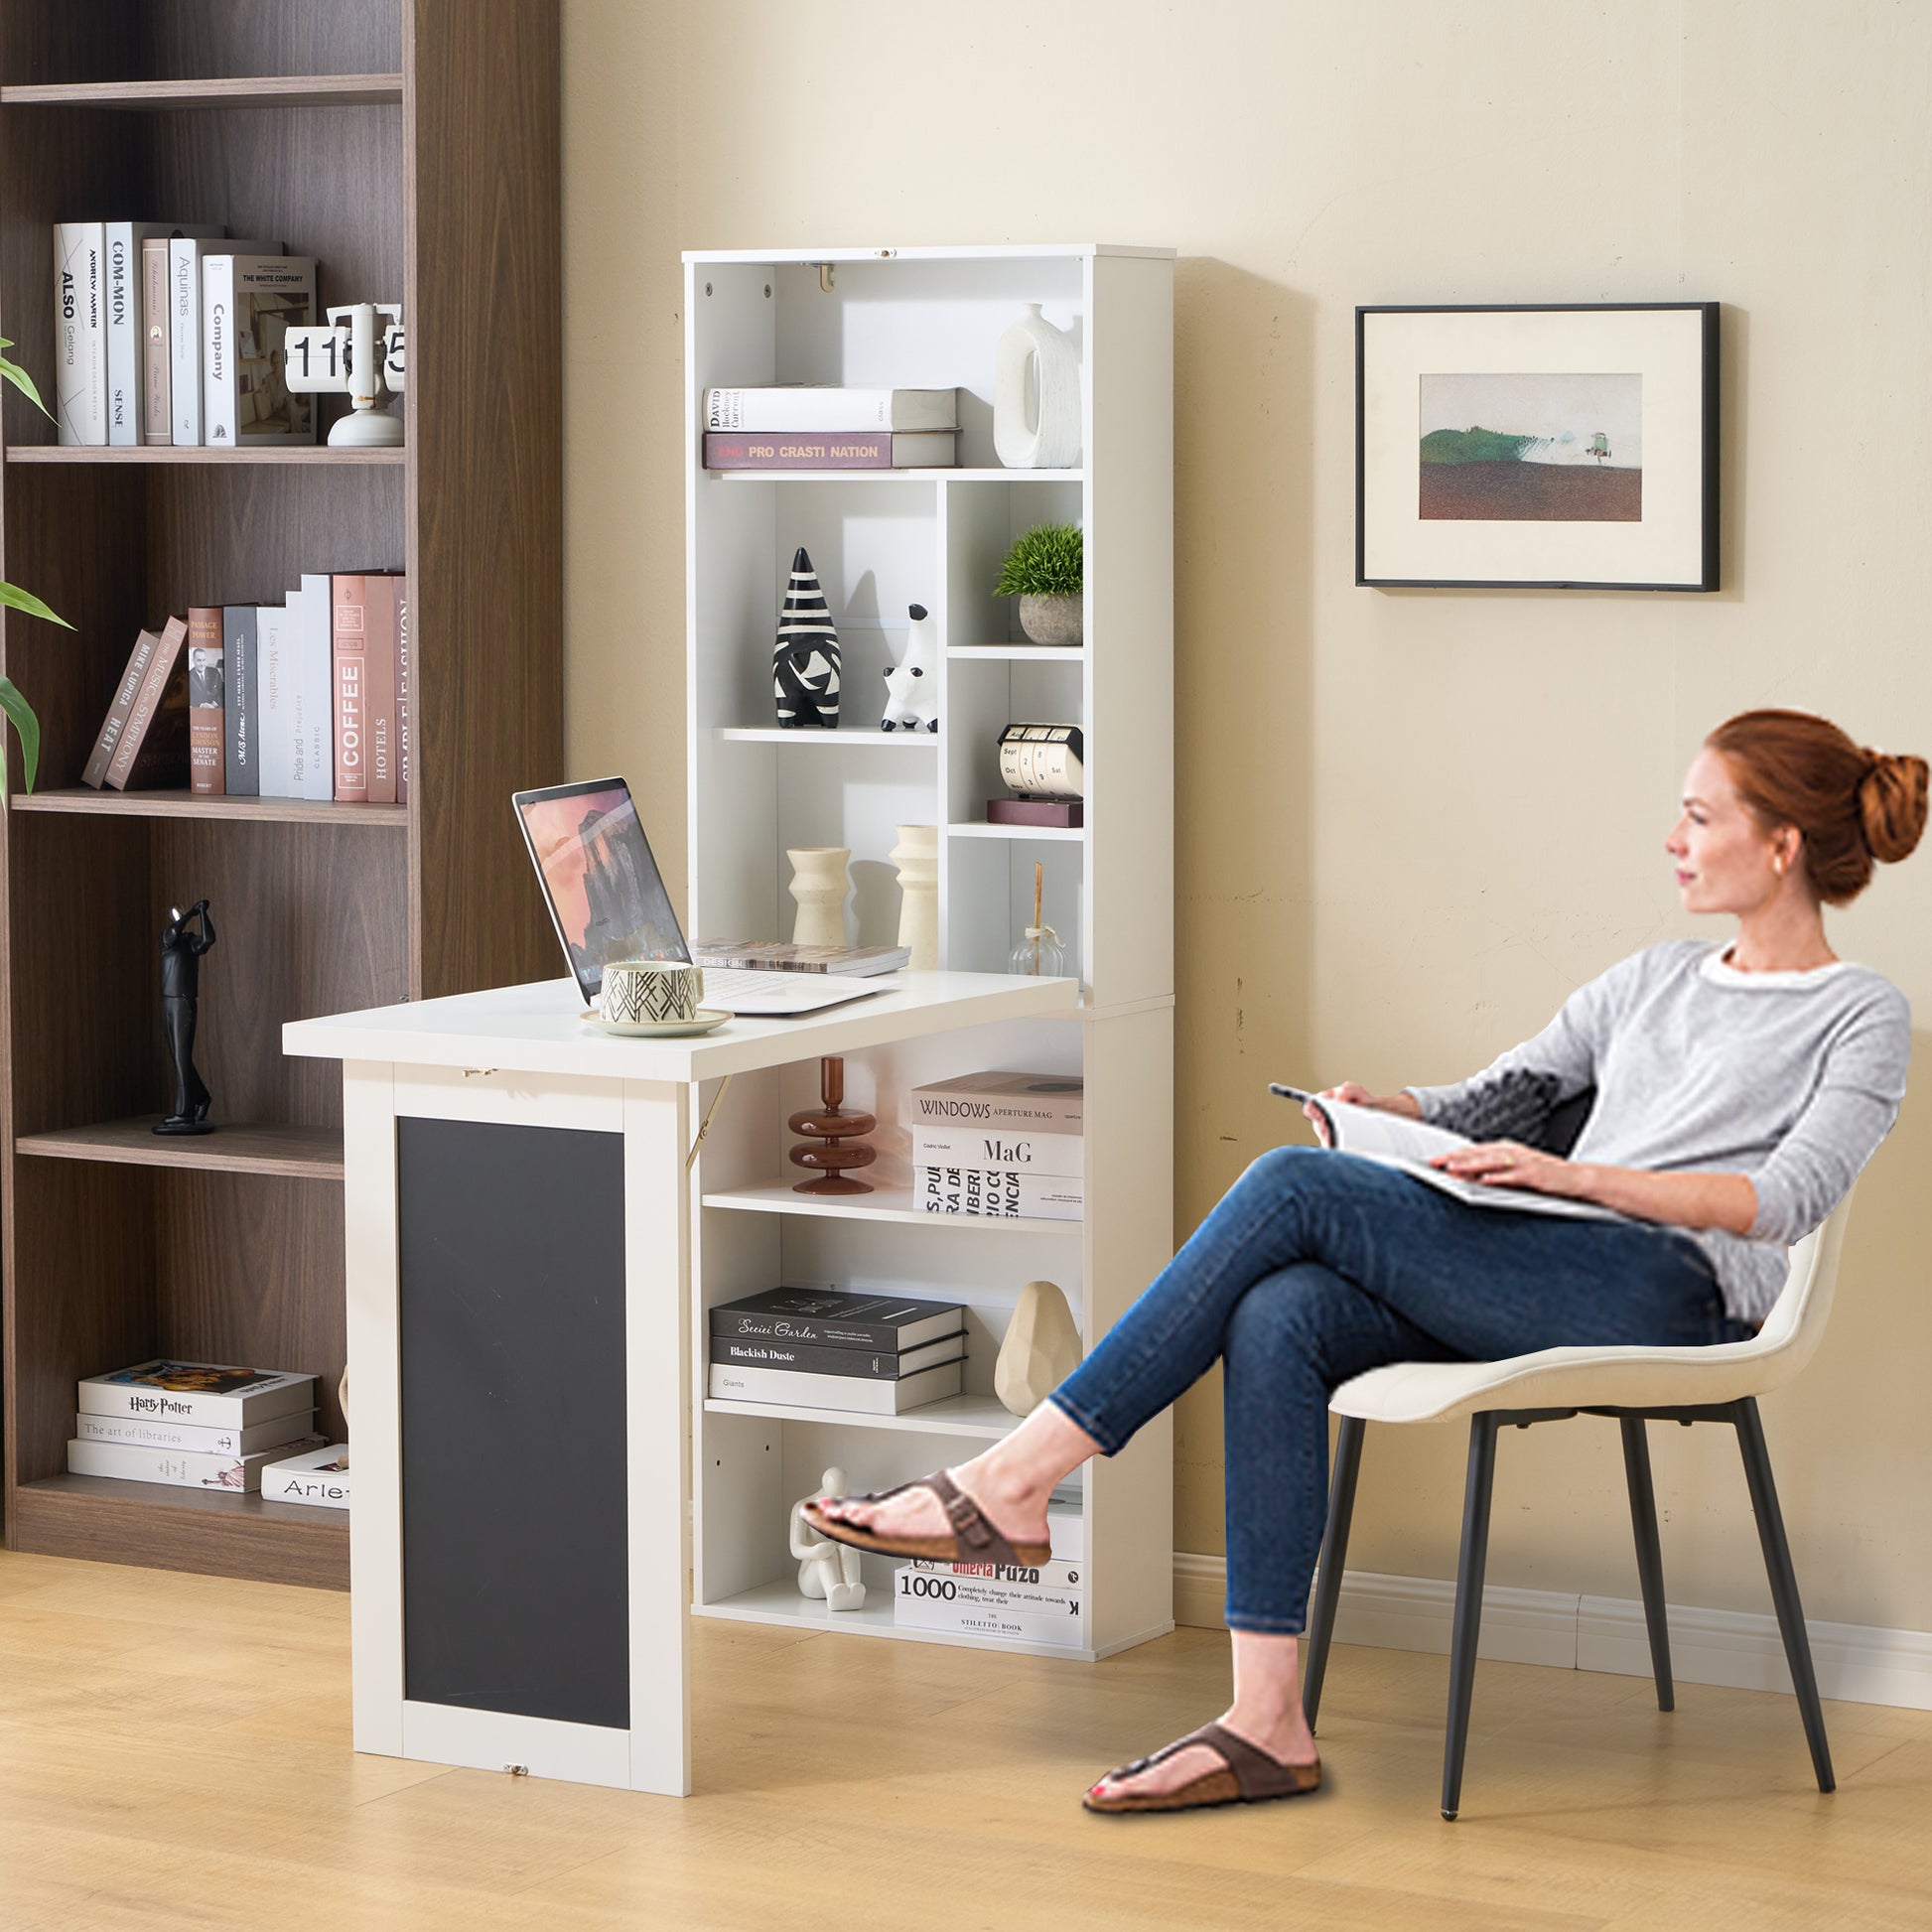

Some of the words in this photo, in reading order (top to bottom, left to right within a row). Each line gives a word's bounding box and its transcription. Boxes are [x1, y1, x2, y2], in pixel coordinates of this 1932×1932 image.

[62, 271, 74, 319] ALSO
[112, 240, 124, 326] COM-MON
[177, 256, 191, 317] Aquinas
[67, 325, 75, 365] Gelang
[211, 303, 224, 381] Company
[295, 337, 336, 377] 11
[114, 389, 123, 428] SENSE
[710, 390, 721, 428] DAVID
[749, 446, 774, 458] PRO
[779, 446, 825, 459] CRASTI
[830, 446, 879, 458] NATION
[134, 643, 151, 670] MIKE
[118, 672, 139, 706] LUPICA
[150, 657, 169, 697] MUSIC
[342, 666, 359, 766] COFFEE
[101, 717, 121, 753] HEAT
[116, 705, 149, 772] SYMPHONY
[294, 738, 304, 756] and
[375, 718, 387, 779] HOTELS
[293, 758, 304, 781] Pride
[703, 958, 743, 967] DESIGN
[919, 1099, 991, 1119] WINDOWS
[993, 1108, 1034, 1118] APERTURE
[1034, 1110, 1052, 1119] MAG
[982, 1140, 1032, 1163] MaG
[774, 1321, 819, 1339] Garden
[730, 1346, 767, 1358] Blackish
[723, 1379, 745, 1389] Giants
[129, 1396, 160, 1412] Harry
[160, 1397, 193, 1416] Potter
[84, 1424, 104, 1436] The
[107, 1427, 123, 1438] art
[125, 1427, 136, 1439] of
[139, 1429, 182, 1444] libraries
[284, 1480, 349, 1500] Arle
[900, 1575, 957, 1601] 1000
[957, 1585, 987, 1595] Completely
[989, 1588, 1008, 1598] change
[961, 1619, 998, 1628] STILETTO
